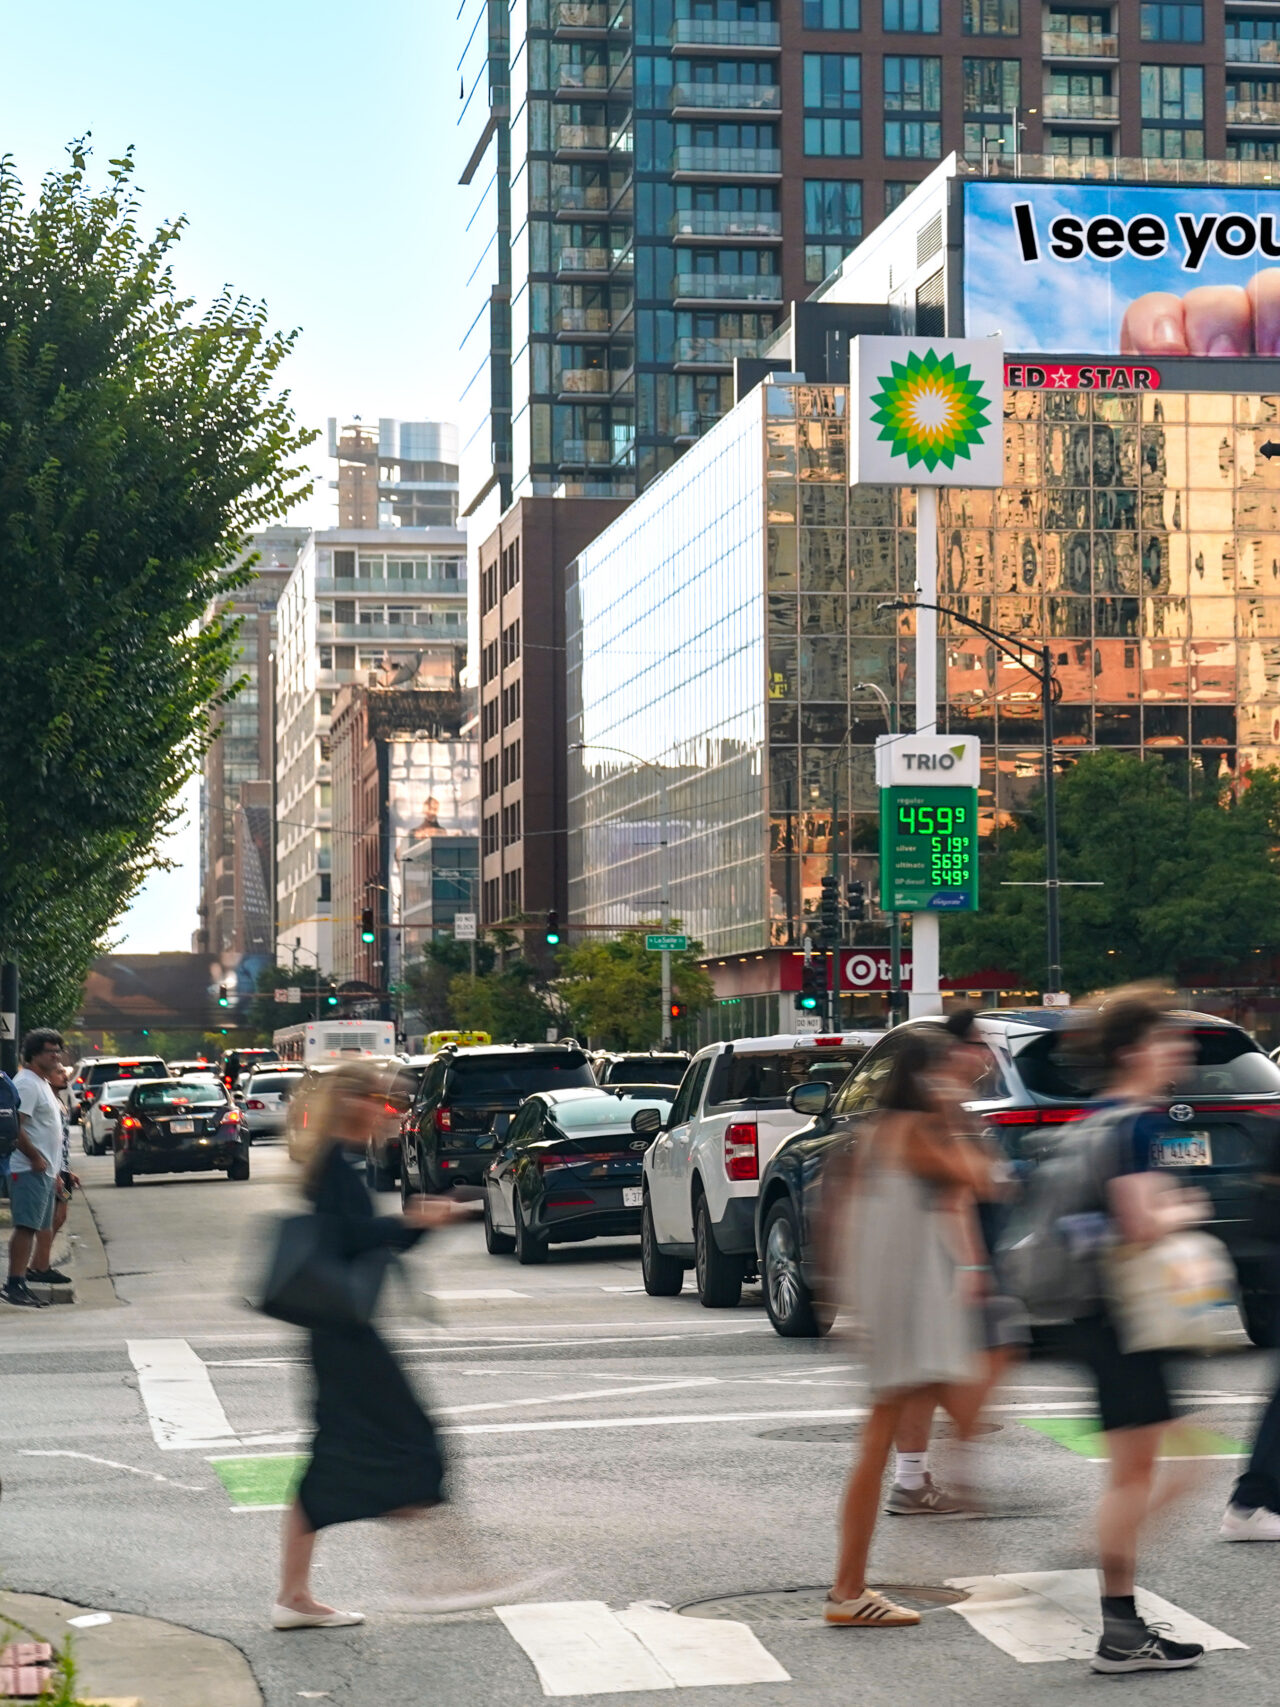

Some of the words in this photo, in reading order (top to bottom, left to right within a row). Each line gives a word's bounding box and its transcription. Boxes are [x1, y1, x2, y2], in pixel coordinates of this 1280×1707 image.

[1013, 203, 1039, 262] I
[1050, 216, 1167, 260] see
[1007, 365, 1047, 388] ED
[1078, 367, 1152, 391] STAR
[902, 753, 955, 771] TRIO
